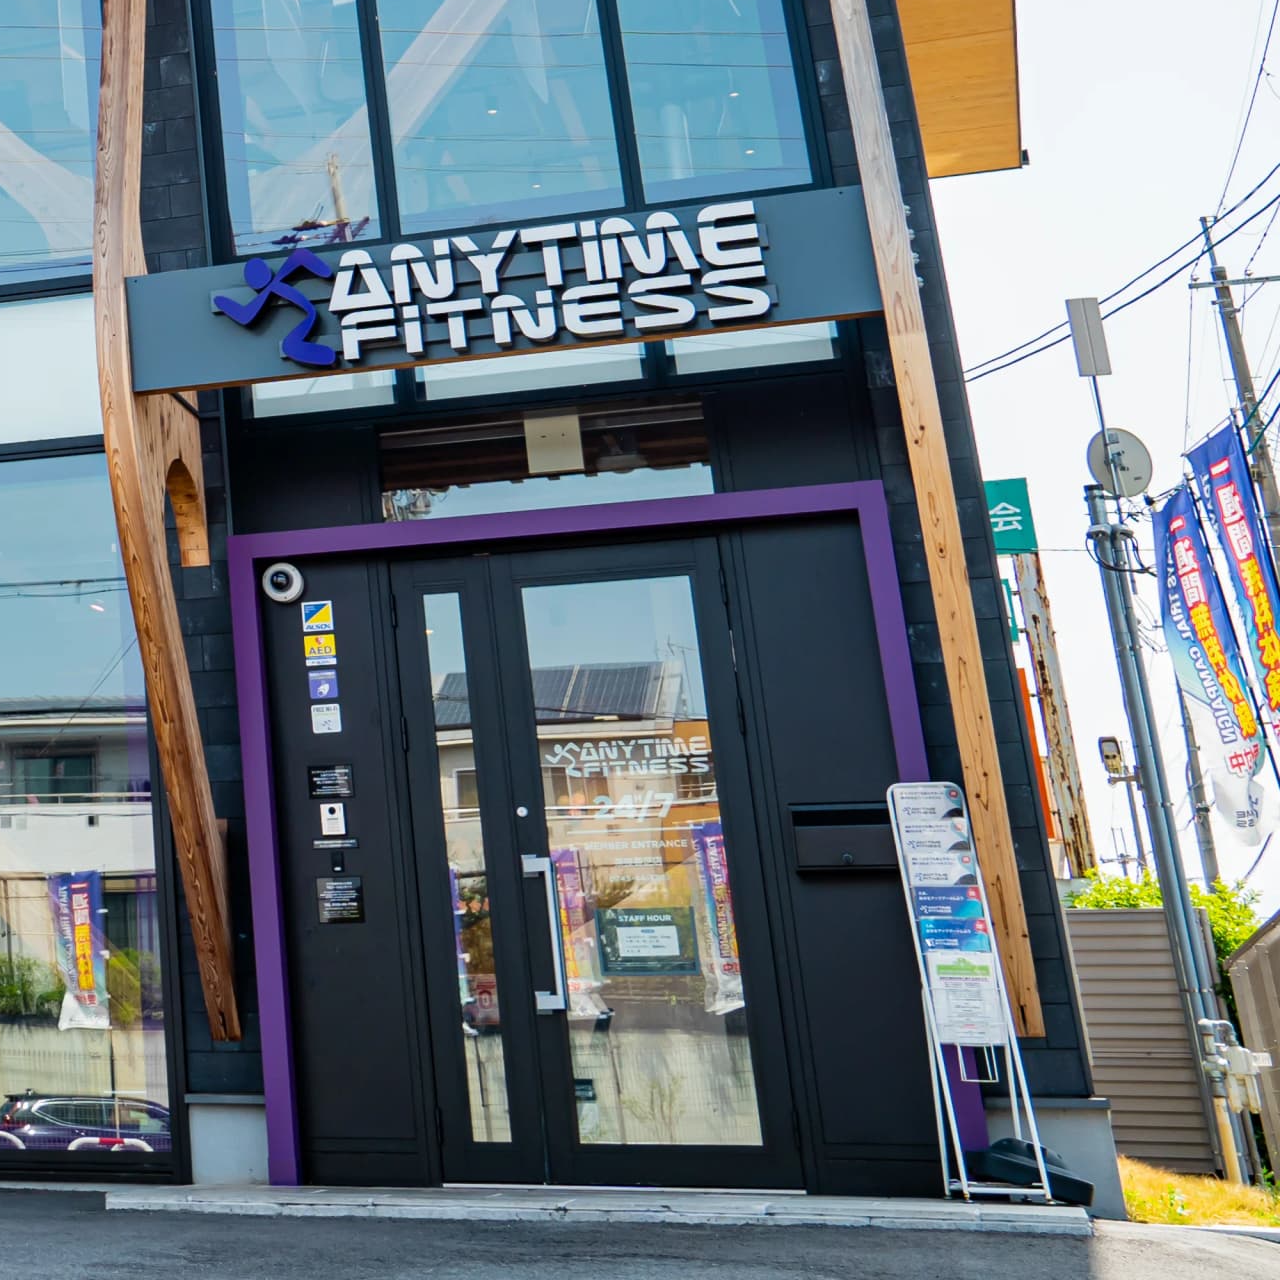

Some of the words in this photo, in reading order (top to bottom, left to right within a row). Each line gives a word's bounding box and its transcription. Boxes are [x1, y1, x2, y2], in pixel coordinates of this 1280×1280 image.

[329, 200, 764, 313] ANYTIME
[340, 264, 773, 361] FITNESS
[990, 502, 1023, 532] 会
[309, 646, 332, 655] AED
[580, 736, 708, 761] ANYTIME
[583, 757, 710, 777] FITNESS
[594, 790, 674, 822] 24/7
[631, 839, 688, 849] ENTRANCE
[618, 914, 645, 923] STAFF
